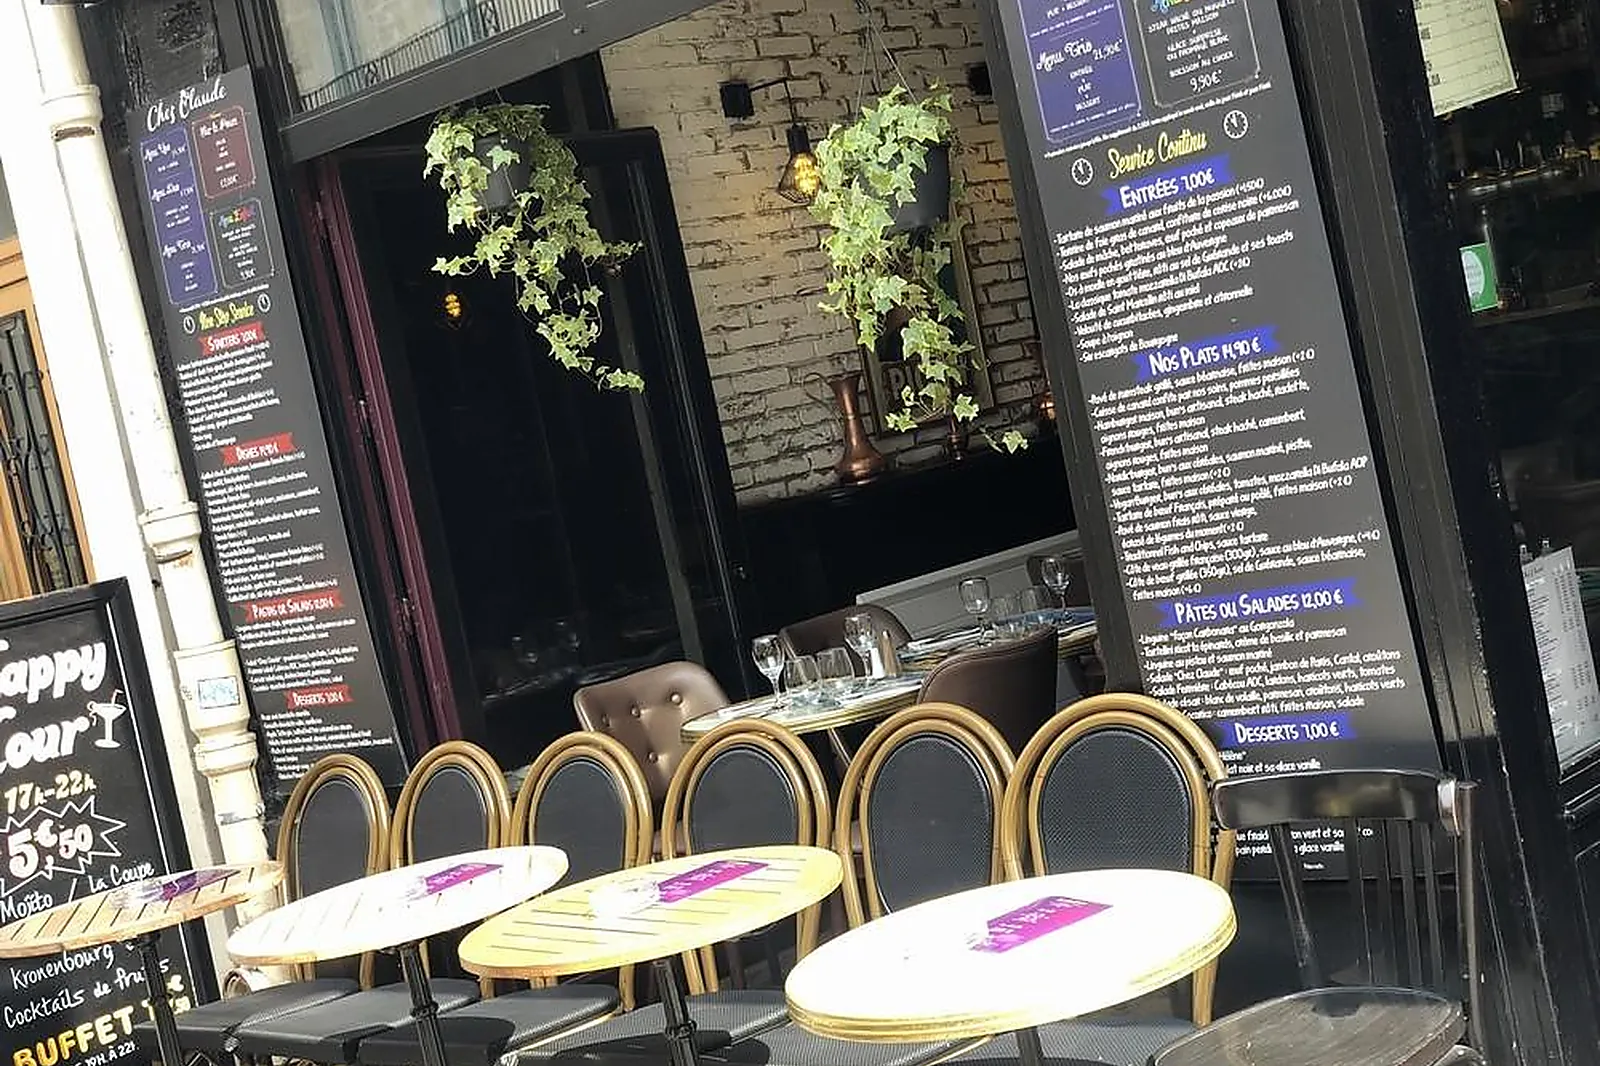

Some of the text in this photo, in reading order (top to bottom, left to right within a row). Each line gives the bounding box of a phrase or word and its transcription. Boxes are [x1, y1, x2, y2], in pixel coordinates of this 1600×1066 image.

[147, 99, 175, 131] Chez
[179, 77, 225, 118] Claude
[1108, 144, 1154, 178] Service
[1158, 129, 1206, 161] Continu
[1120, 168, 1214, 207] ENTRÉES 7,00€
[1149, 352, 1179, 375] NOS
[1179, 345, 1219, 368] PLATS
[1251, 336, 1261, 352] €
[1174, 602, 1217, 623] PÂTES
[1239, 593, 1299, 615] SALADES
[1301, 590, 1331, 608] 12,00
[1333, 588, 1343, 604] €
[0, 641, 107, 703] appy
[0, 706, 90, 773] our
[1235, 721, 1339, 742] DESSERTS 7,00 €
[0, 890, 53, 923] Mojito
[110, 862, 155, 885] Coupe
[10, 943, 114, 990] Kronenbourg
[4, 988, 86, 1030] Cocktails
[93, 981, 112, 998] de
[13, 1005, 135, 1066] BUFFET
